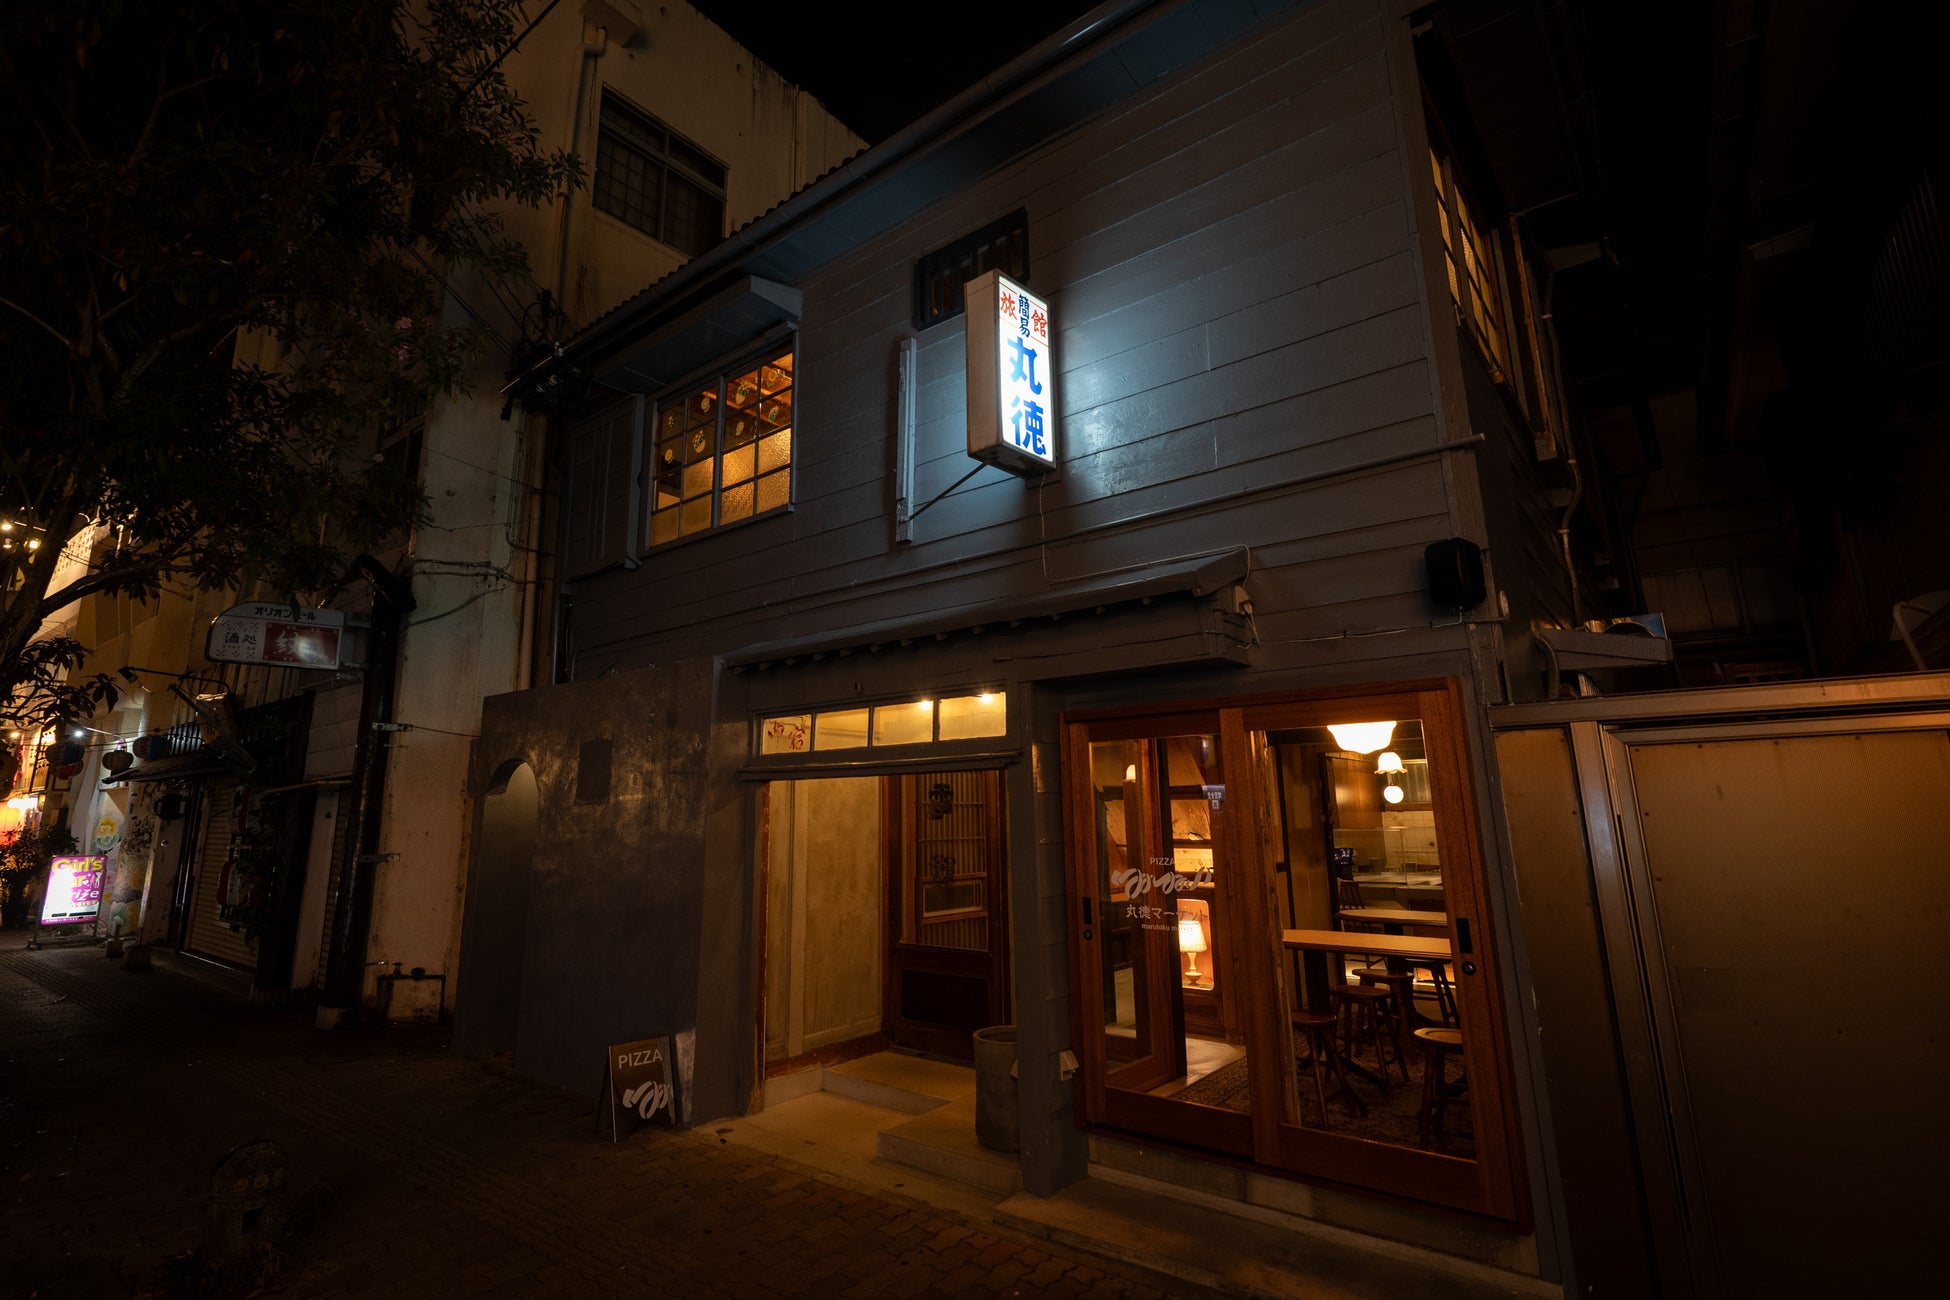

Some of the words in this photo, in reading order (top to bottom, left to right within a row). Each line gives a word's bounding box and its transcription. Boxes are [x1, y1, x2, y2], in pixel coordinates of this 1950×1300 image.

[1007, 336, 1047, 456] 丸徳
[255, 606, 316, 620] オリオンール
[52, 857, 103, 873] Girl's
[1150, 857, 1175, 866] PIZZA
[1127, 904, 1208, 921] 丸徳マーケット
[1142, 923, 1170, 931] marutoku
[618, 1049, 663, 1069] PIZZA
